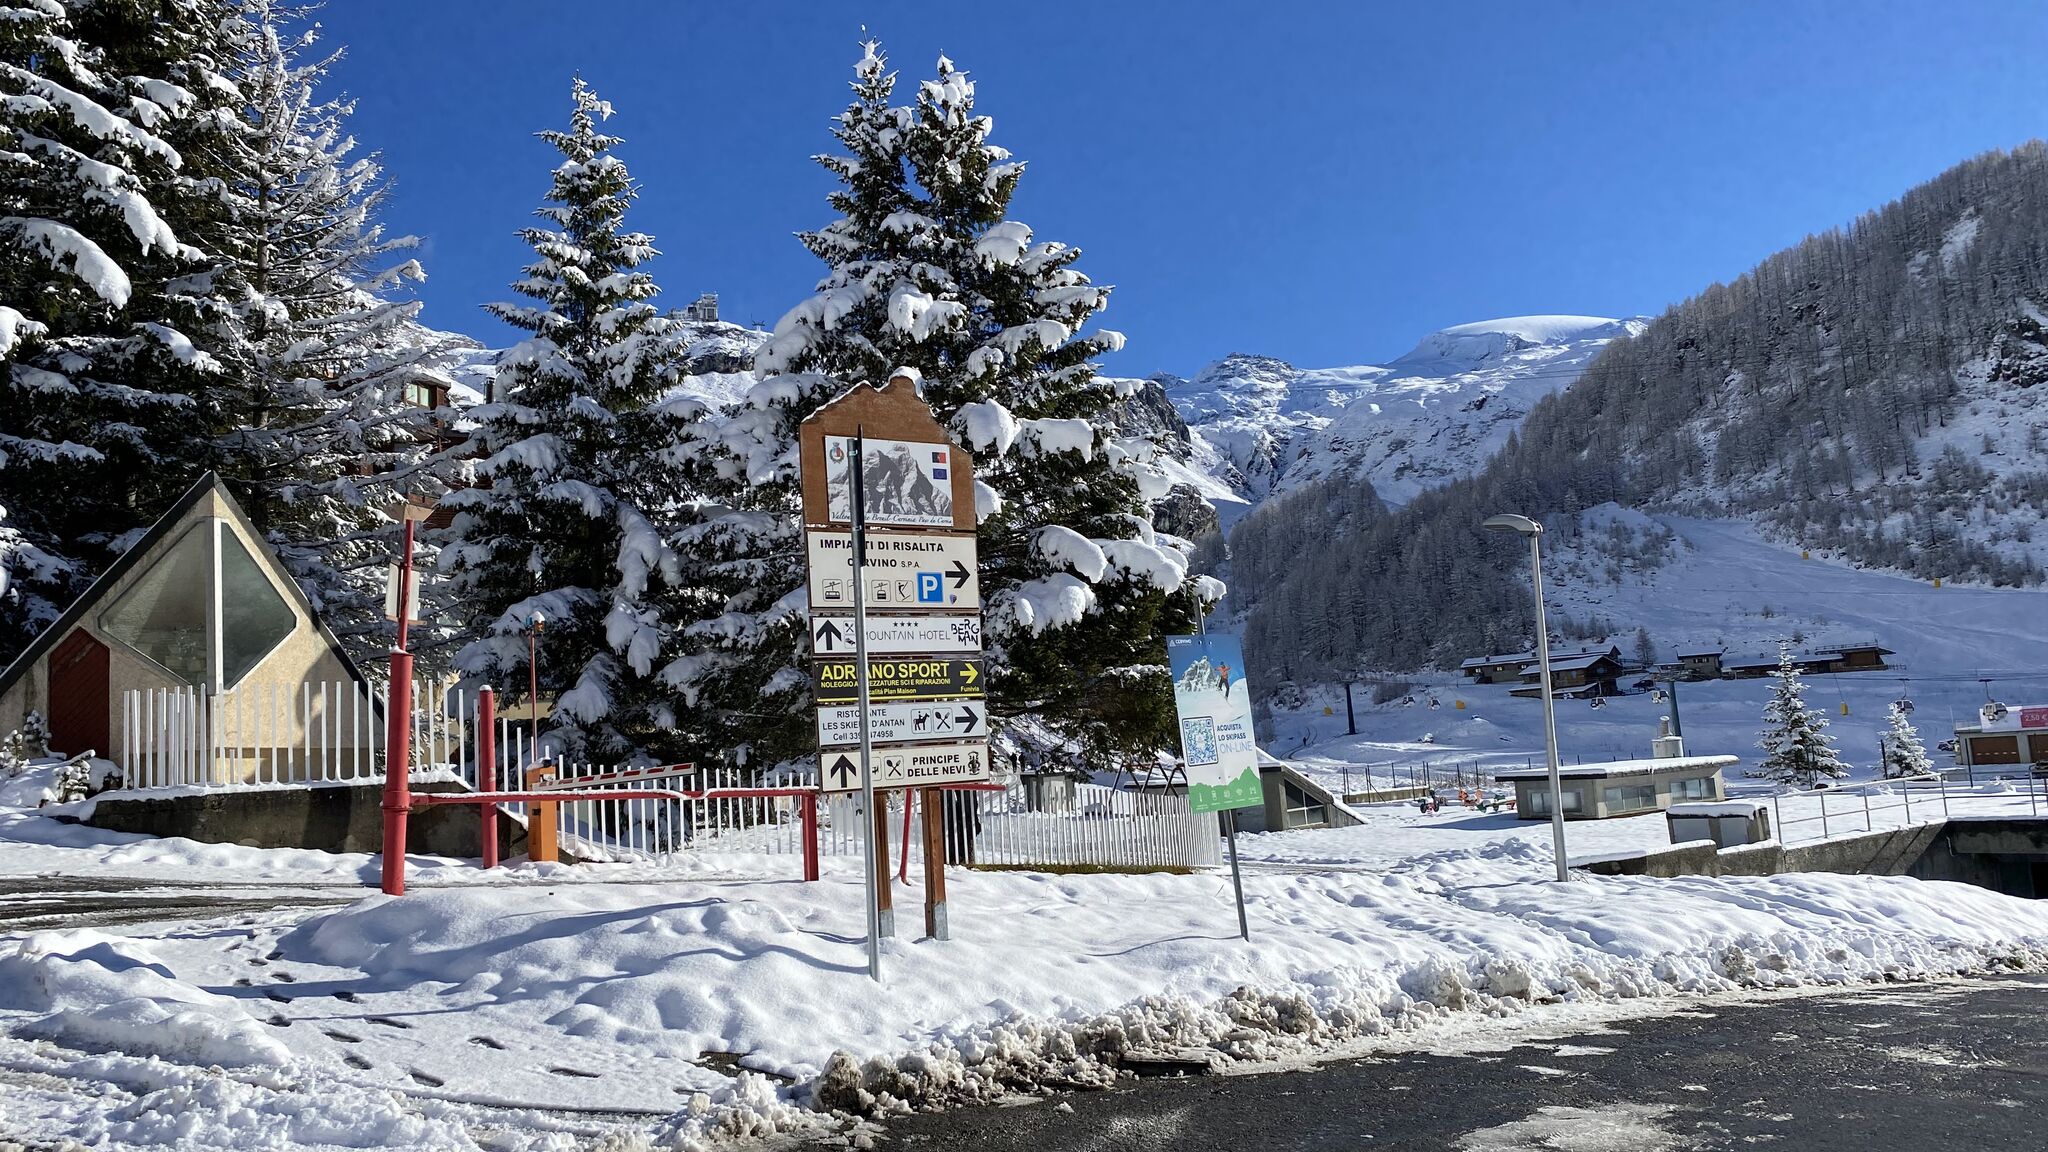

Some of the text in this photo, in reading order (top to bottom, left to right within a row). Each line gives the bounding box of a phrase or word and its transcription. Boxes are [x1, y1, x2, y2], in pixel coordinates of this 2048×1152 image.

[820, 539, 944, 552] IMPIATI DI RISALITA
[847, 558, 897, 568] CRVINO
[922, 575, 938, 599] P
[920, 630, 950, 640] HOTEL
[898, 663, 950, 679] SPORT
[836, 709, 887, 718] RISTONTE
[822, 722, 838, 730] LES
[871, 719, 905, 727] D'ANTAN
[1217, 723, 1242, 732] ACQUISTA
[833, 732, 848, 740] Cell
[1226, 732, 1246, 740] SKIPASS
[1220, 741, 1253, 753] ON-LINE
[912, 754, 960, 766] PRINCIPE
[907, 765, 966, 778] DELLE NEVI
